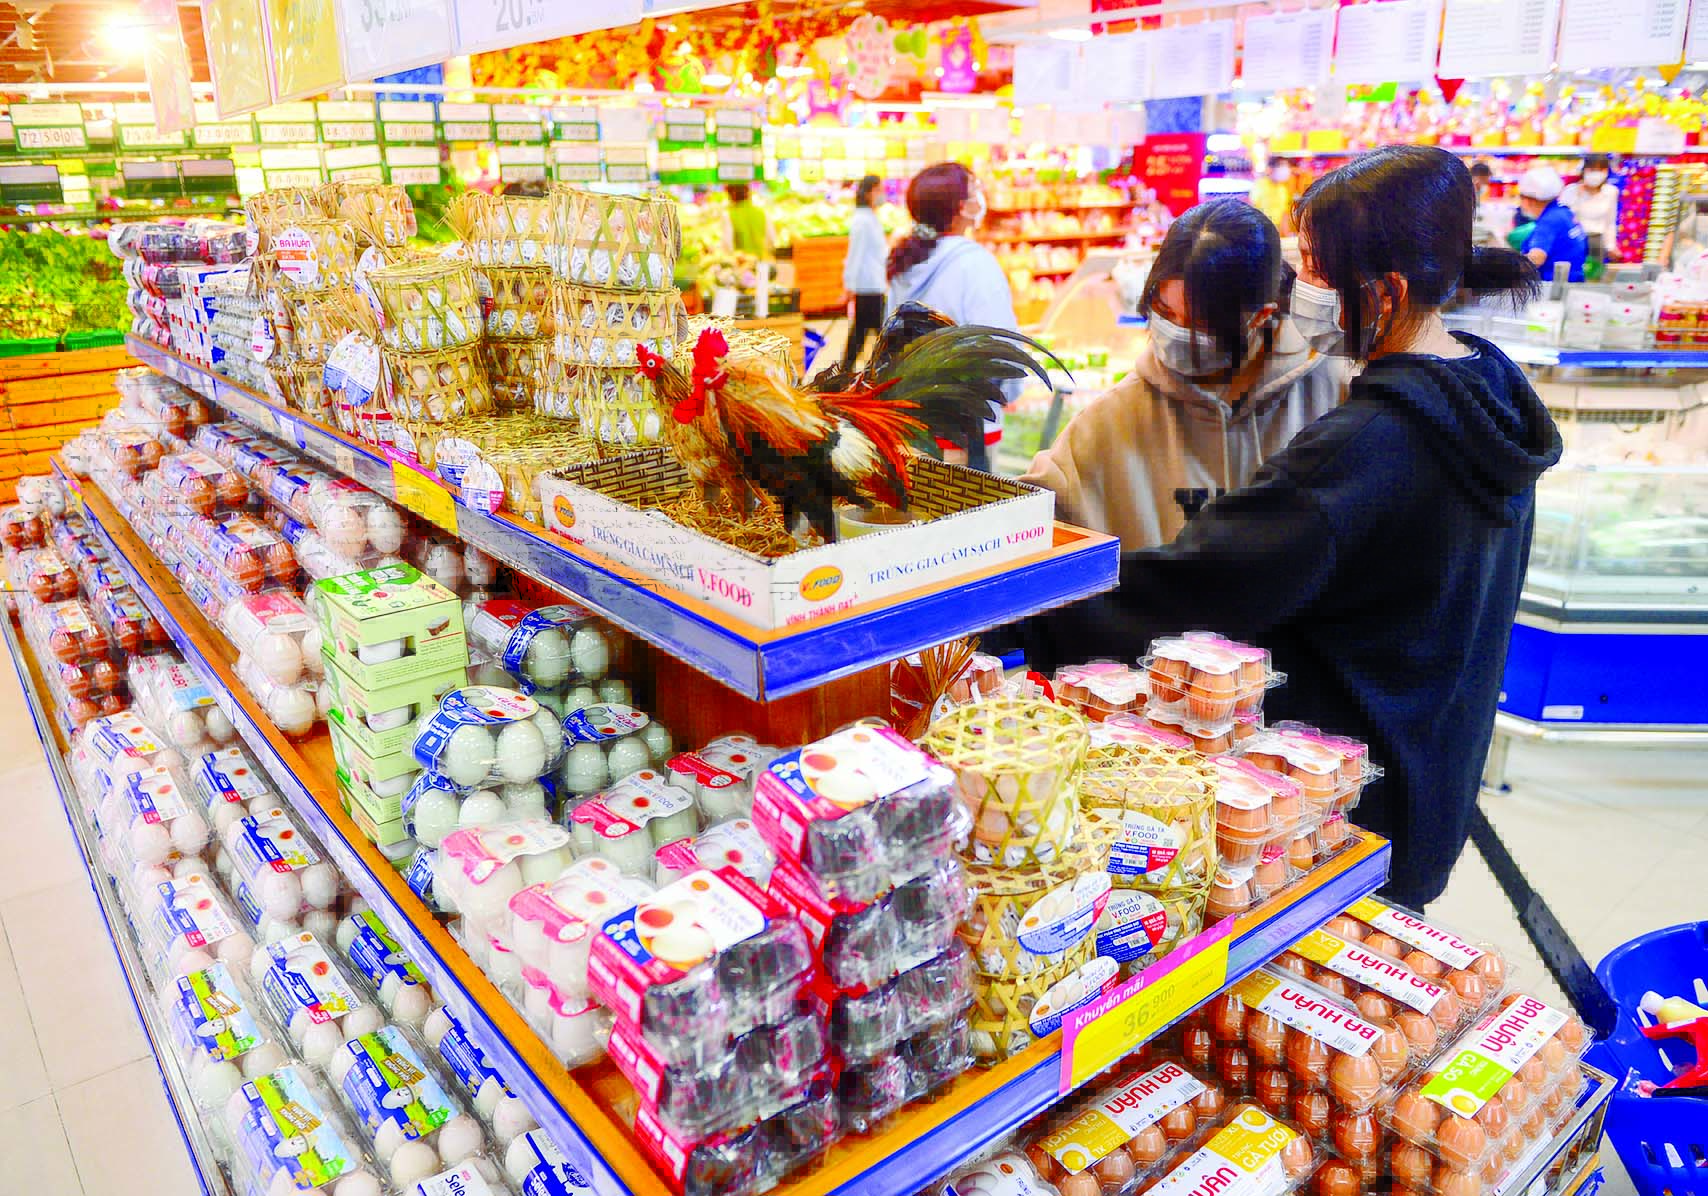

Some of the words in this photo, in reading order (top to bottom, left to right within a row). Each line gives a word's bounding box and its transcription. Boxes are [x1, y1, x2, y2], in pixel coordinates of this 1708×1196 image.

[867, 563, 914, 586] TRỨNG
[916, 555, 939, 571] GIA
[970, 536, 1001, 558] SẠCH
[1005, 525, 1045, 546] V.FOOD
[697, 567, 753, 607] V.FOOD
[1125, 830, 1159, 840] V.FOOD
[1111, 903, 1141, 919] V.FOOD
[1392, 911, 1449, 942] HUÂN
[1451, 938, 1479, 957] BA
[1346, 949, 1406, 981] HUÂN
[1410, 974, 1441, 998] BA
[1075, 990, 1120, 1030] Khuyến
[1123, 976, 1145, 999] mãi
[1280, 987, 1339, 1024] HUÂN
[1516, 998, 1546, 1019] BA
[1344, 1018, 1377, 1040] BA
[1479, 1015, 1529, 1052] HUÂN
[1153, 1065, 1183, 1083] BA
[1105, 1079, 1160, 1115] HUÂN
[1242, 1148, 1264, 1169] GÀ
[1261, 1127, 1290, 1152] TƯƠI
[1188, 1167, 1239, 1196] UÂN
